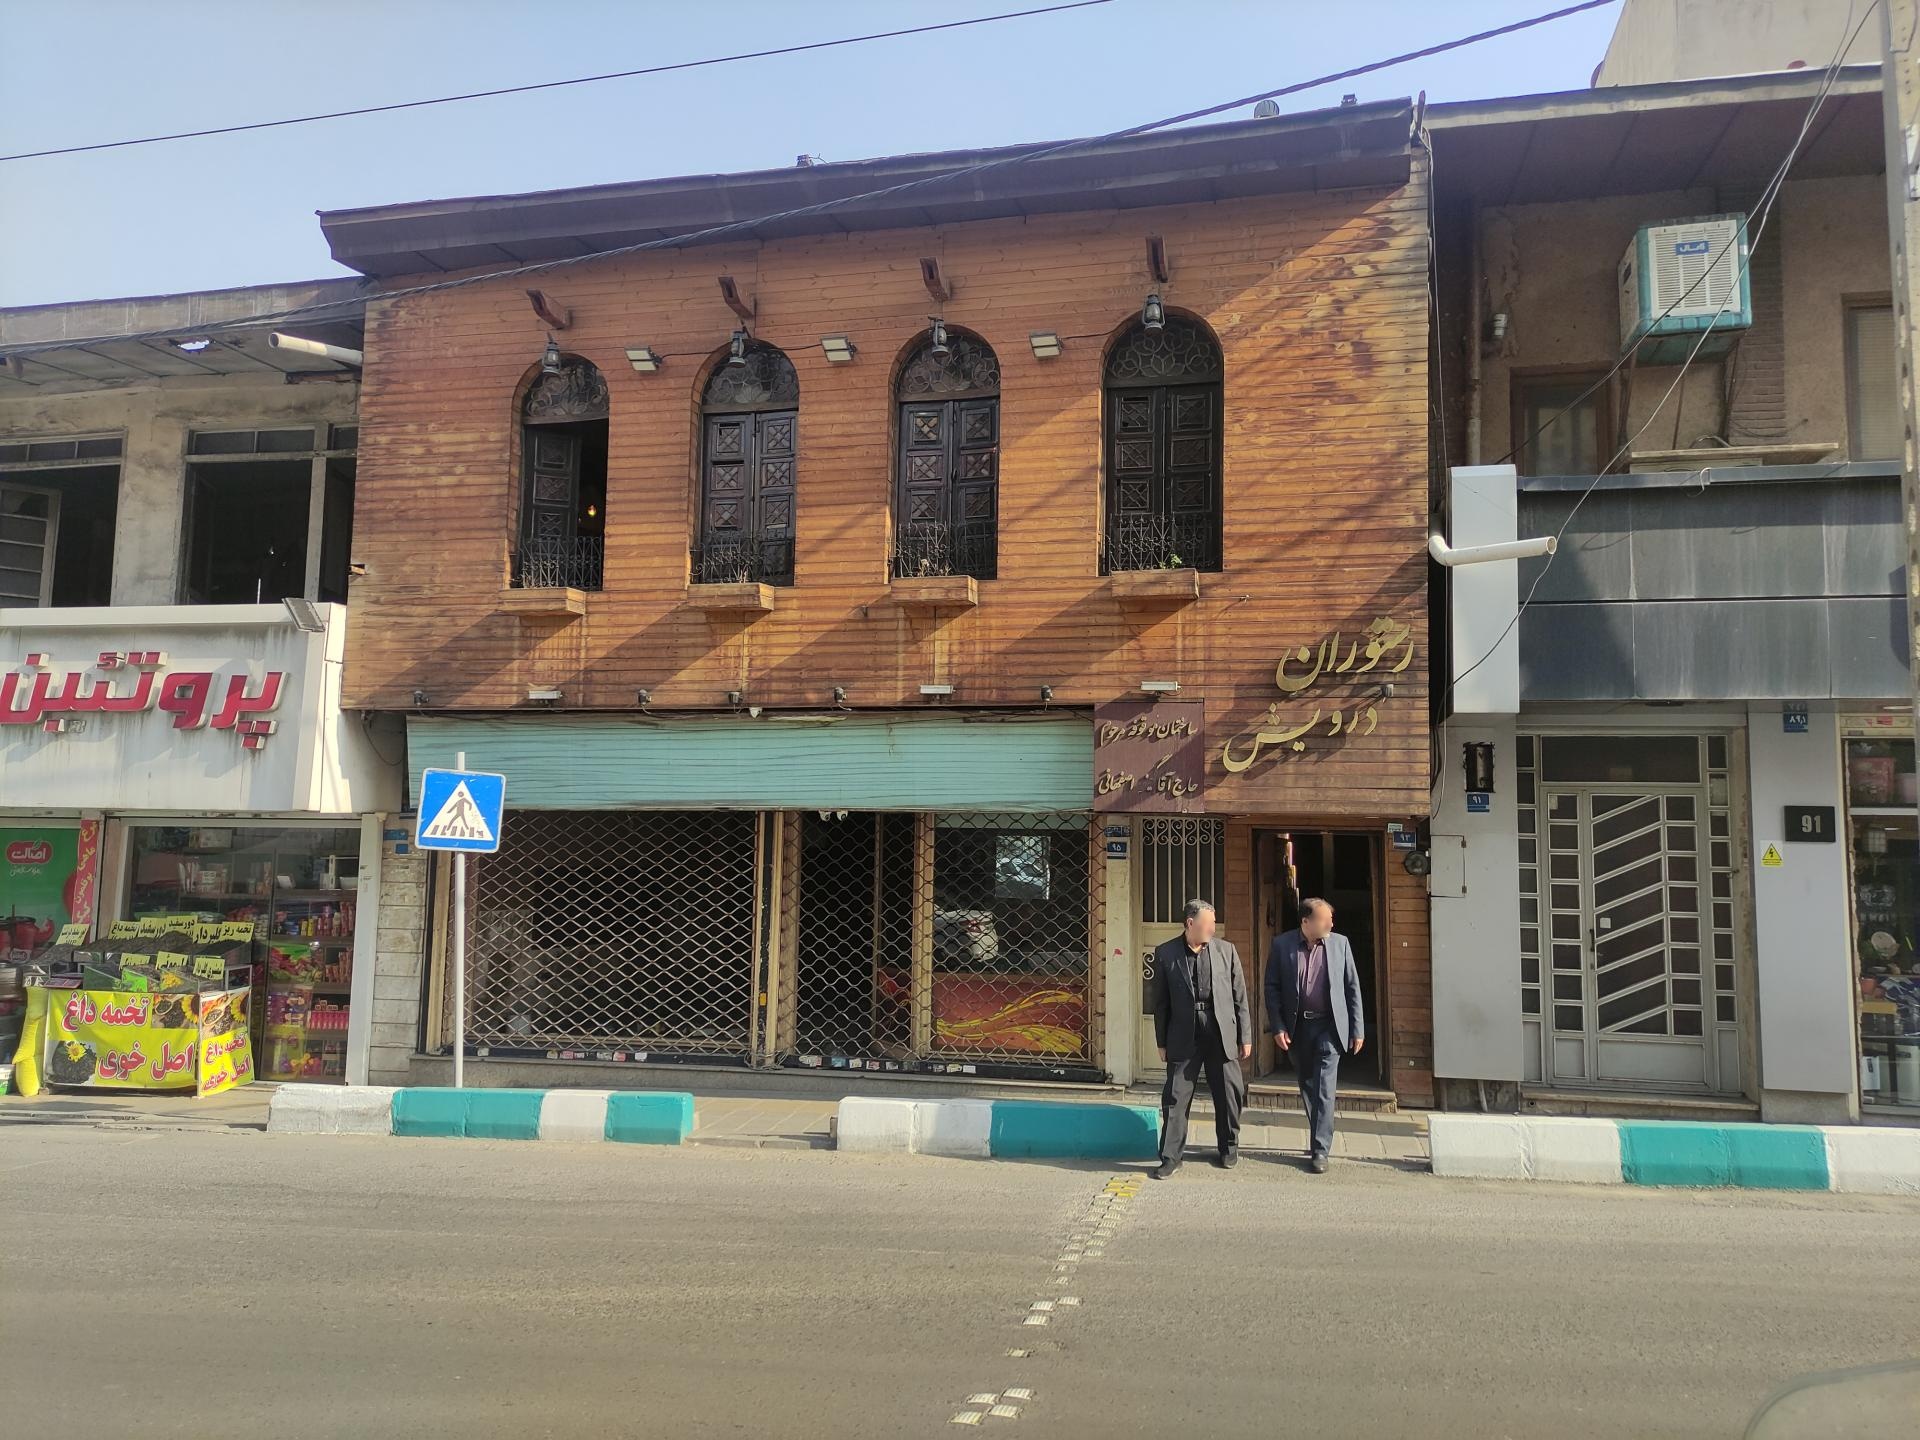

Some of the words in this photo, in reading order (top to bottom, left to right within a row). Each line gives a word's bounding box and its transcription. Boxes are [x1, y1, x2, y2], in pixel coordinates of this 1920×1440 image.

[1276, 616, 1414, 692] رستوران
[0, 651, 284, 749] پروتئین
[1100, 720, 1126, 746] مرحوم
[1127, 716, 1158, 737] موقوفه
[1157, 716, 1198, 738] ساختمان
[1223, 703, 1378, 772] درویش
[1098, 768, 1135, 794] اصفهانی
[1157, 771, 1177, 792] آقا
[1172, 777, 1199, 797] حاج
[1801, 814, 1821, 833] 91
[11, 847, 47, 860] اصالت
[62, 991, 97, 1031] داغ
[101, 995, 150, 1026] تخمه
[205, 1042, 223, 1064] داغ
[224, 1032, 247, 1053] تخمه
[98, 1040, 146, 1080] خوی
[151, 1040, 195, 1080] اصل
[230, 1055, 250, 1083] اصل
[203, 1064, 228, 1091] خوی
